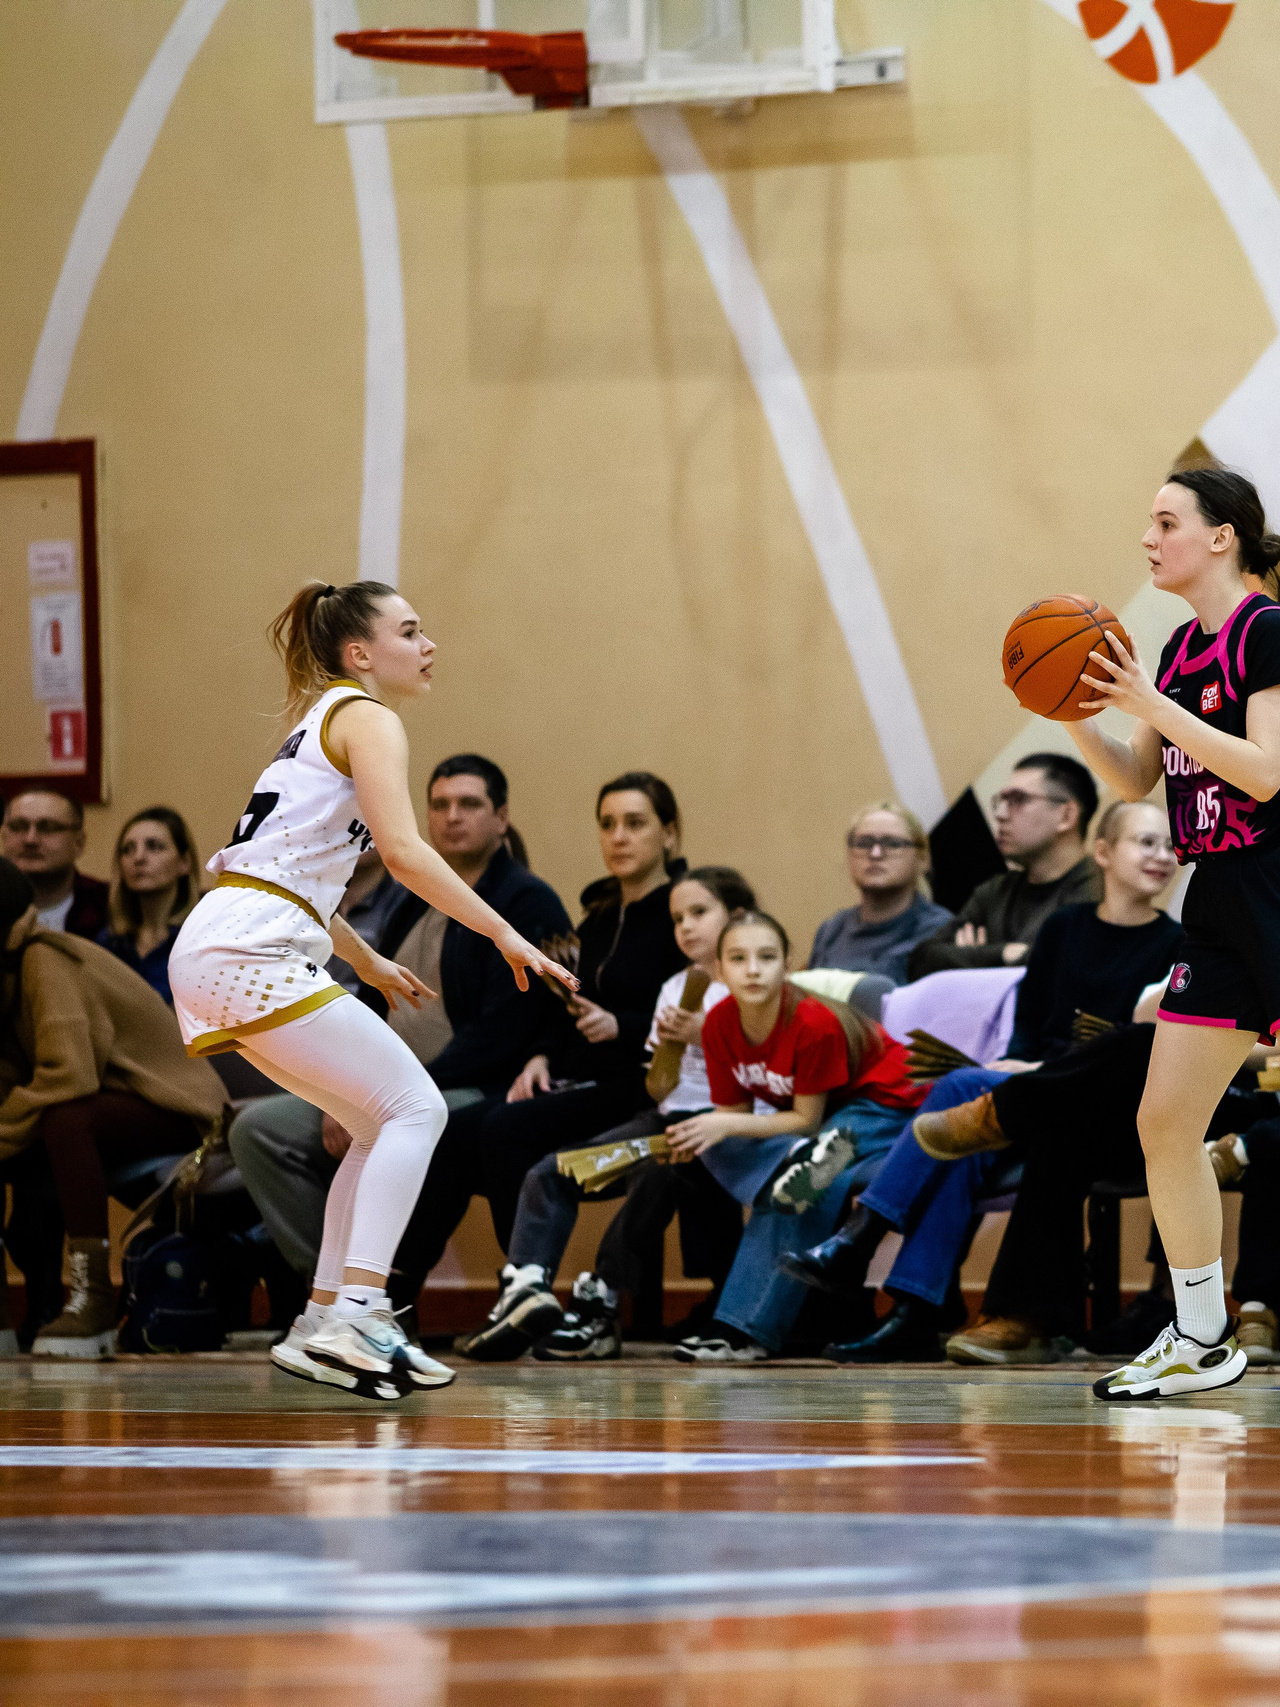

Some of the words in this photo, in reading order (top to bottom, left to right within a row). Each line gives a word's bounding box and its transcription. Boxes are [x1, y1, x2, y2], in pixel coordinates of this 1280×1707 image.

[1007, 646, 1025, 670] FIBA
[1201, 684, 1218, 700] FON
[1202, 696, 1219, 711] BET
[1195, 785, 1221, 830] 85
